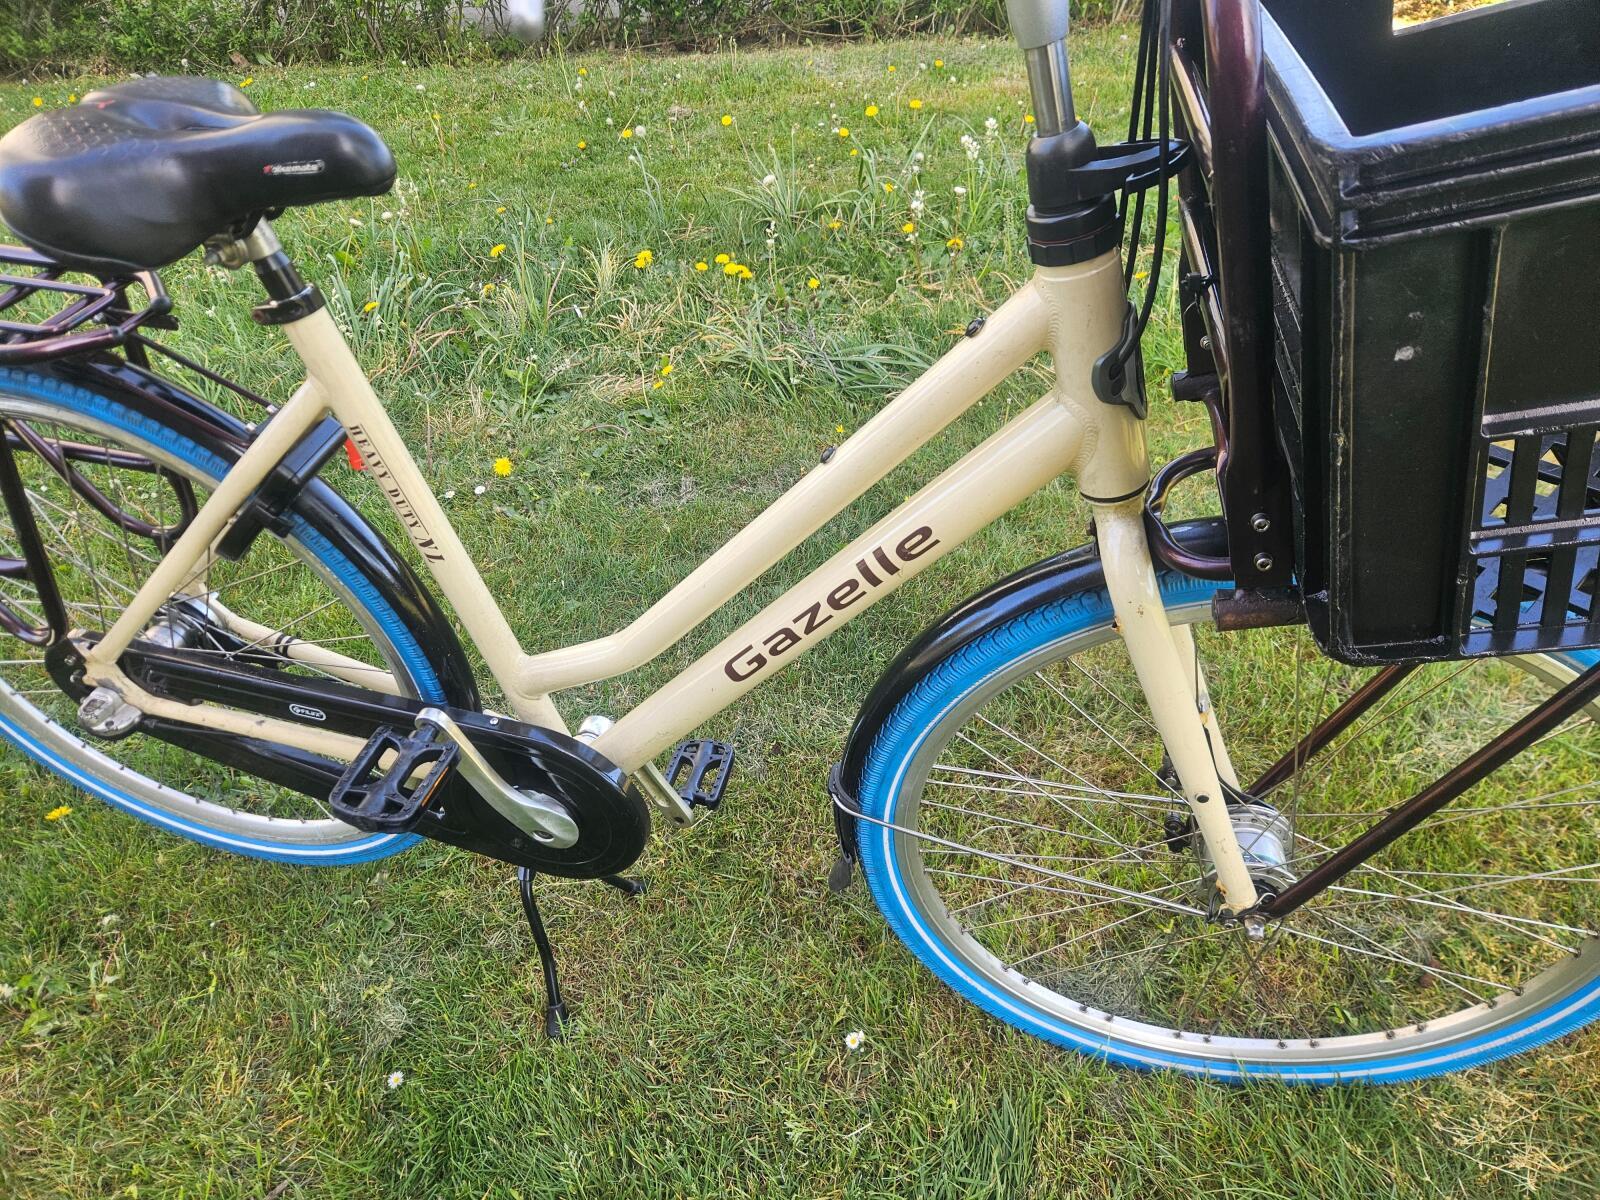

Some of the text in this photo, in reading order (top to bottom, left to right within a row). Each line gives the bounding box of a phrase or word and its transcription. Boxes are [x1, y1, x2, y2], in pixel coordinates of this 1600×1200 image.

[350, 425, 445, 564] HEAVY DUTY NL
[724, 525, 941, 683] Gazelle
